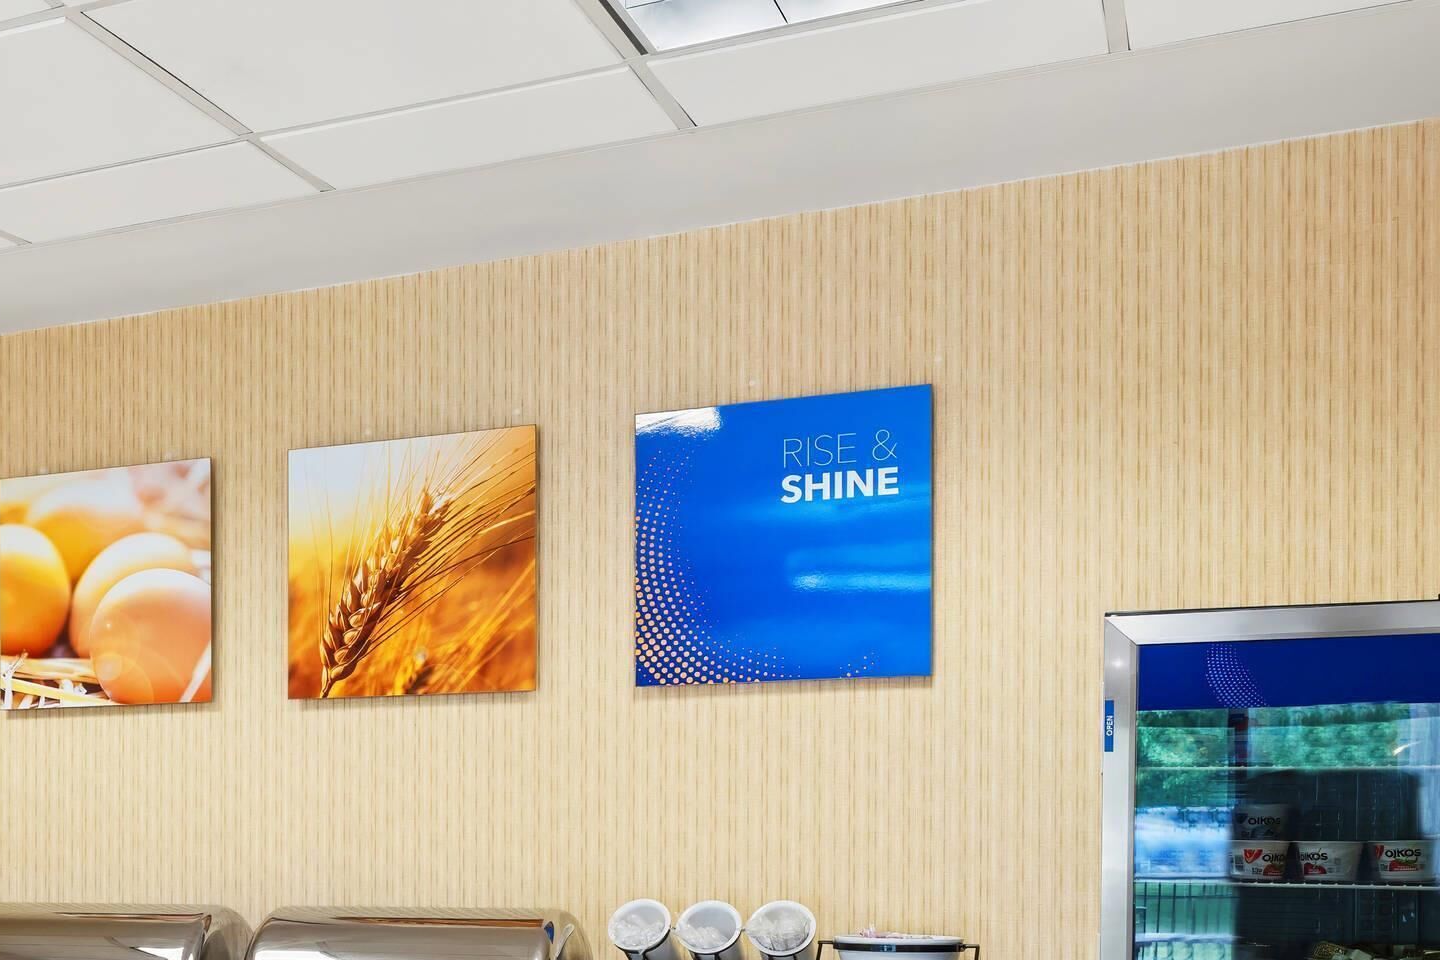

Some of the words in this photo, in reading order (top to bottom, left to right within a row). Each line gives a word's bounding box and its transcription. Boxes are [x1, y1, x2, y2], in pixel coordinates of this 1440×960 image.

[782, 432, 857, 468] RISE
[872, 429, 898, 461] &
[780, 466, 899, 504] SHINE
[1106, 715, 1114, 737] OPEN
